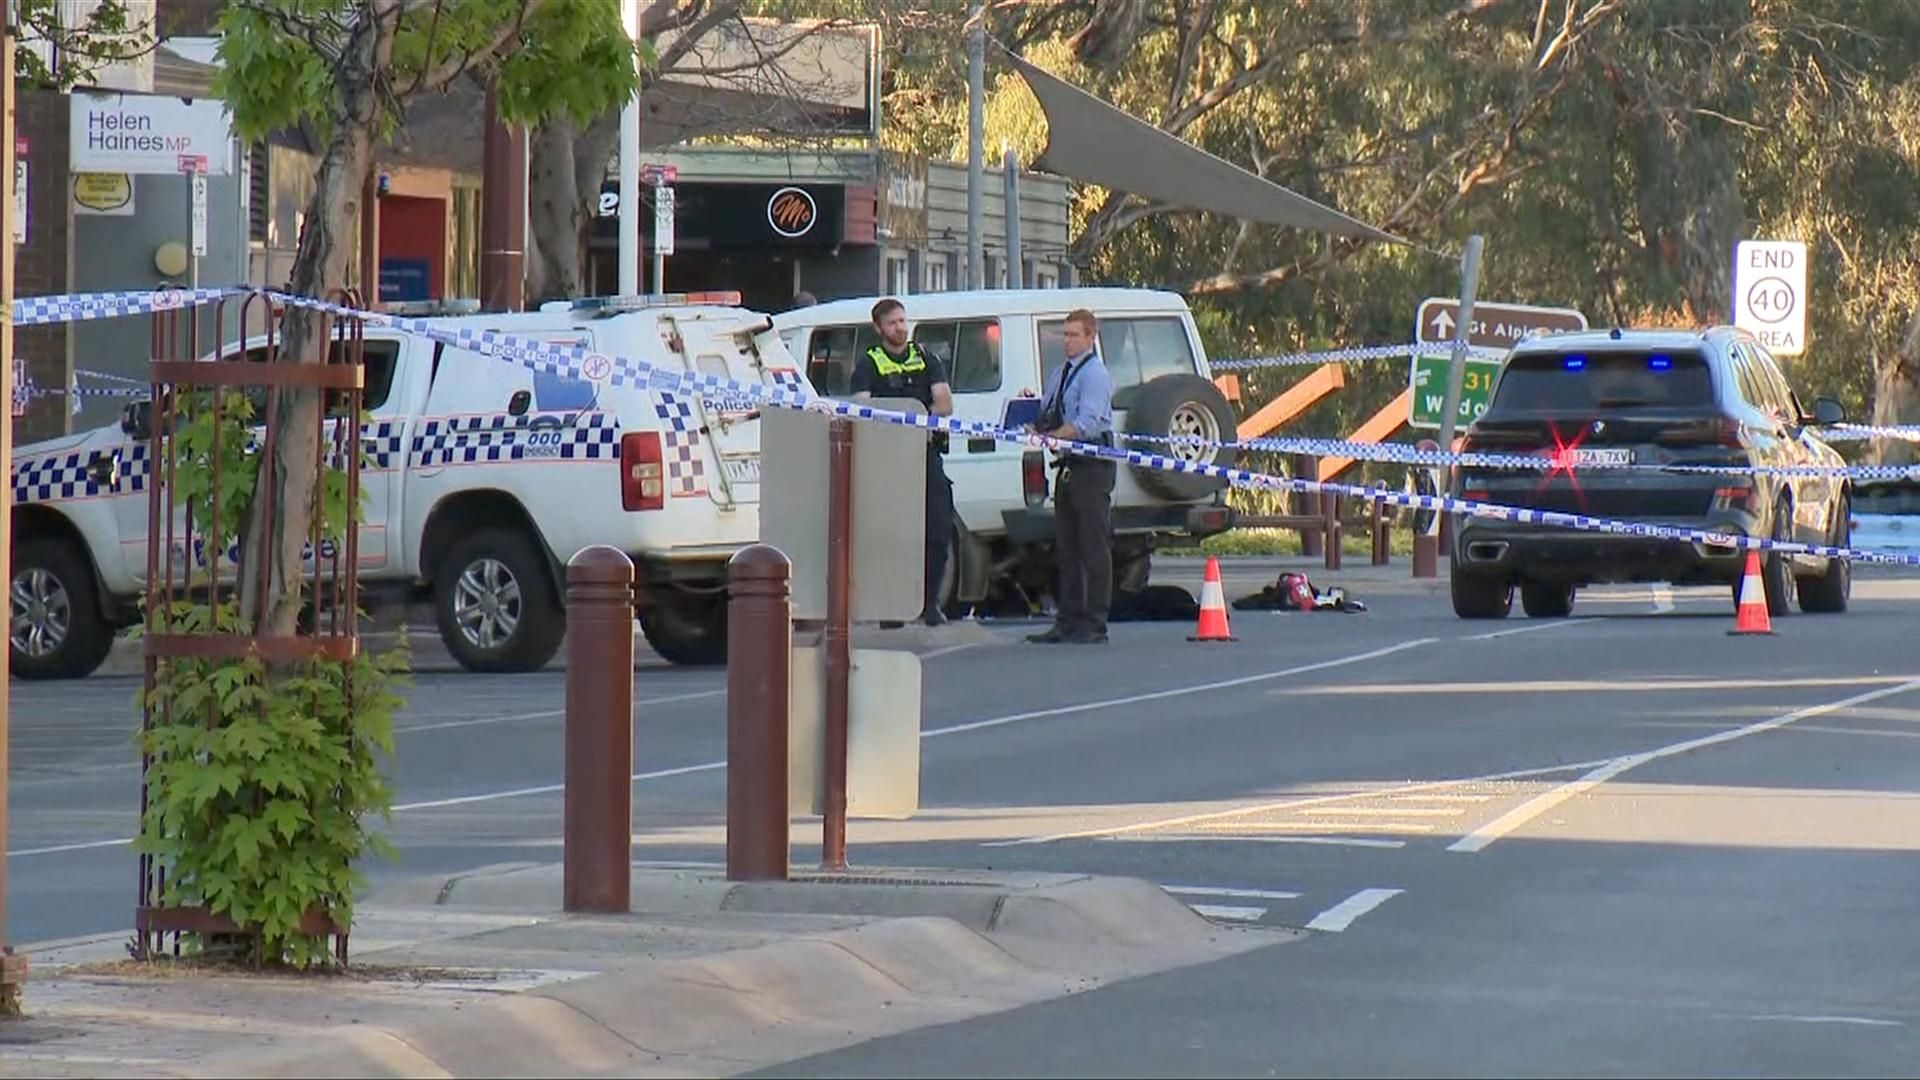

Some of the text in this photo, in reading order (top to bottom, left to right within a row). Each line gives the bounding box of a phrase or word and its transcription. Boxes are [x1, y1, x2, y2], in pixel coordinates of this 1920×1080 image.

[88, 110, 151, 130] Helen
[88, 131, 192, 151] Haines MP
[1750, 249, 1794, 269] END
[1753, 289, 1789, 311] 40
[1756, 330, 1795, 348] REA
[703, 398, 753, 413] Police
[528, 432, 562, 446] 000
